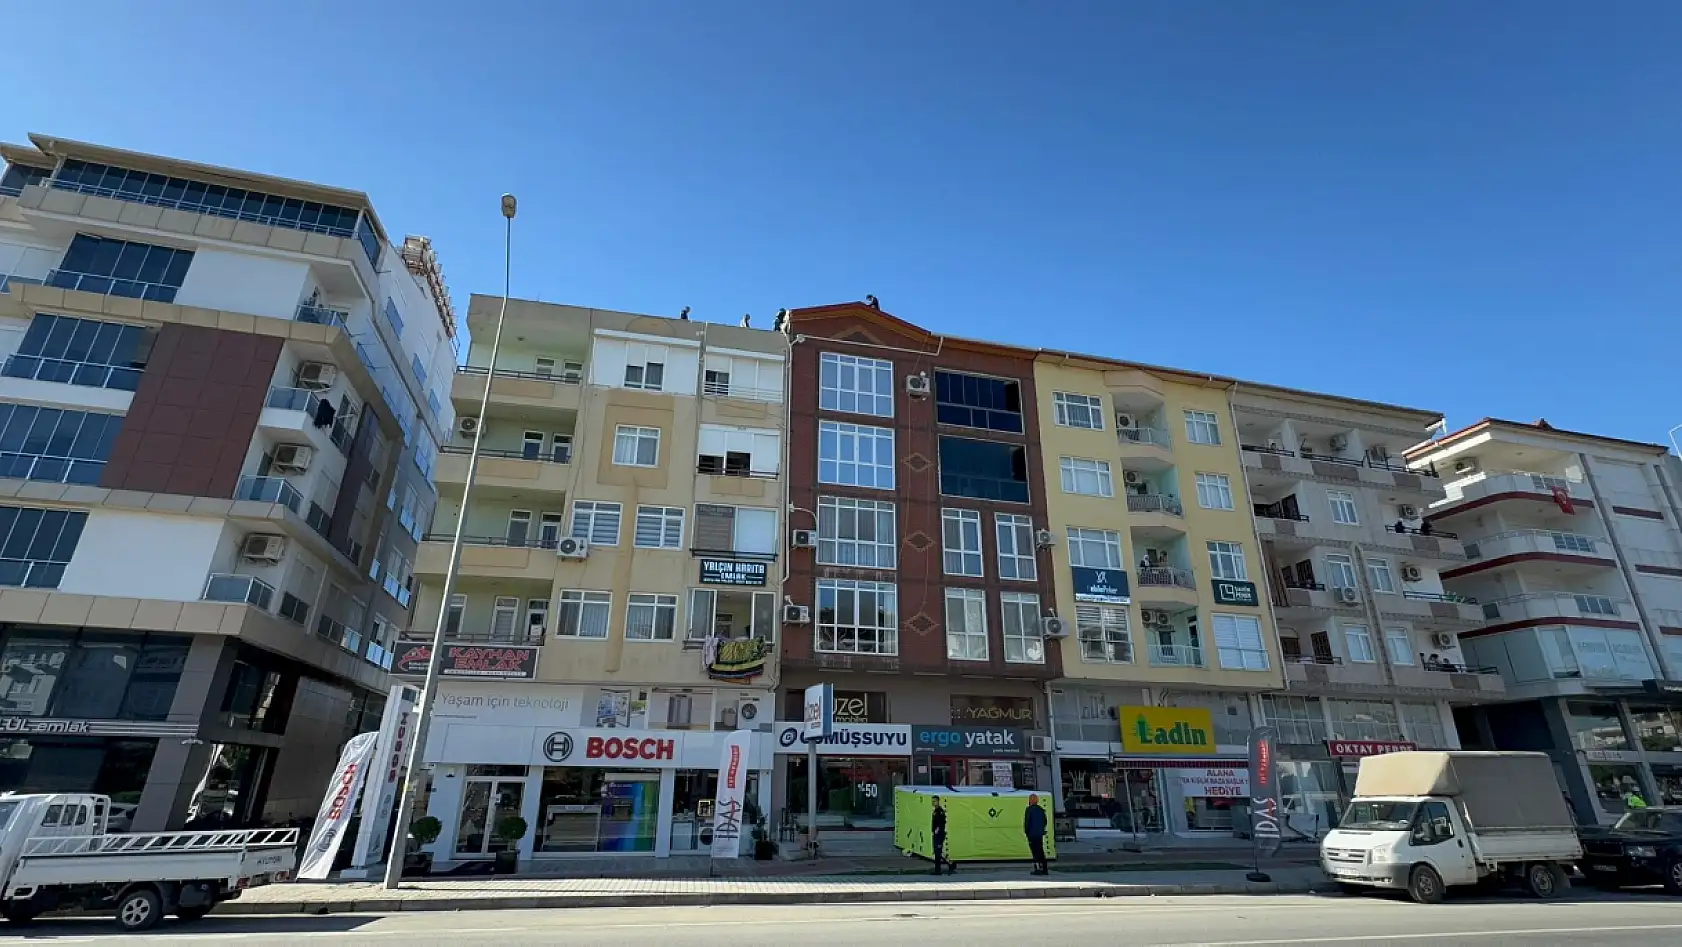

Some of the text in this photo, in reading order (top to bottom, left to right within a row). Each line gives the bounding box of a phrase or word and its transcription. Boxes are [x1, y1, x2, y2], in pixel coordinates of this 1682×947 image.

[448, 647, 530, 660] KAYHAN
[454, 659, 522, 670] EMLAK
[441, 693, 483, 708] Yaşam
[513, 697, 569, 712] teknoloji
[37, 721, 89, 732] emlak
[1136, 714, 1208, 746] Ladin
[586, 736, 675, 760] BOSCH
[920, 729, 1015, 748] ergo yatak
[1336, 743, 1373, 755] OKTAY
[328, 762, 360, 821] BOSCH
